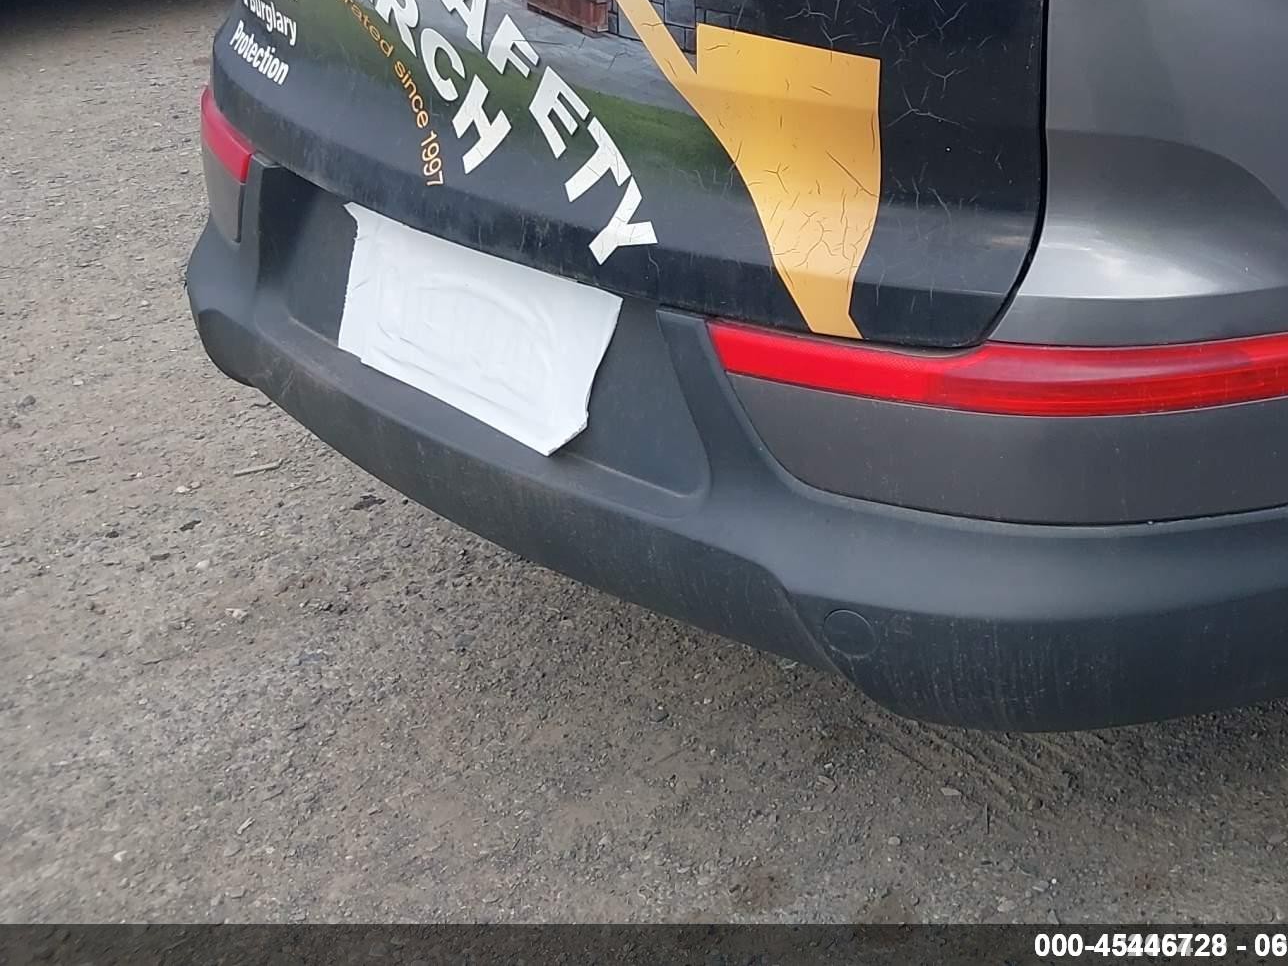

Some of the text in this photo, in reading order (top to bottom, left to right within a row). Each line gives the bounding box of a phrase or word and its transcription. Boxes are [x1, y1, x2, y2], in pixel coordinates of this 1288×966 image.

[228, 18, 290, 86] Protection
[393, 57, 430, 130] since
[419, 130, 445, 188] 1997
